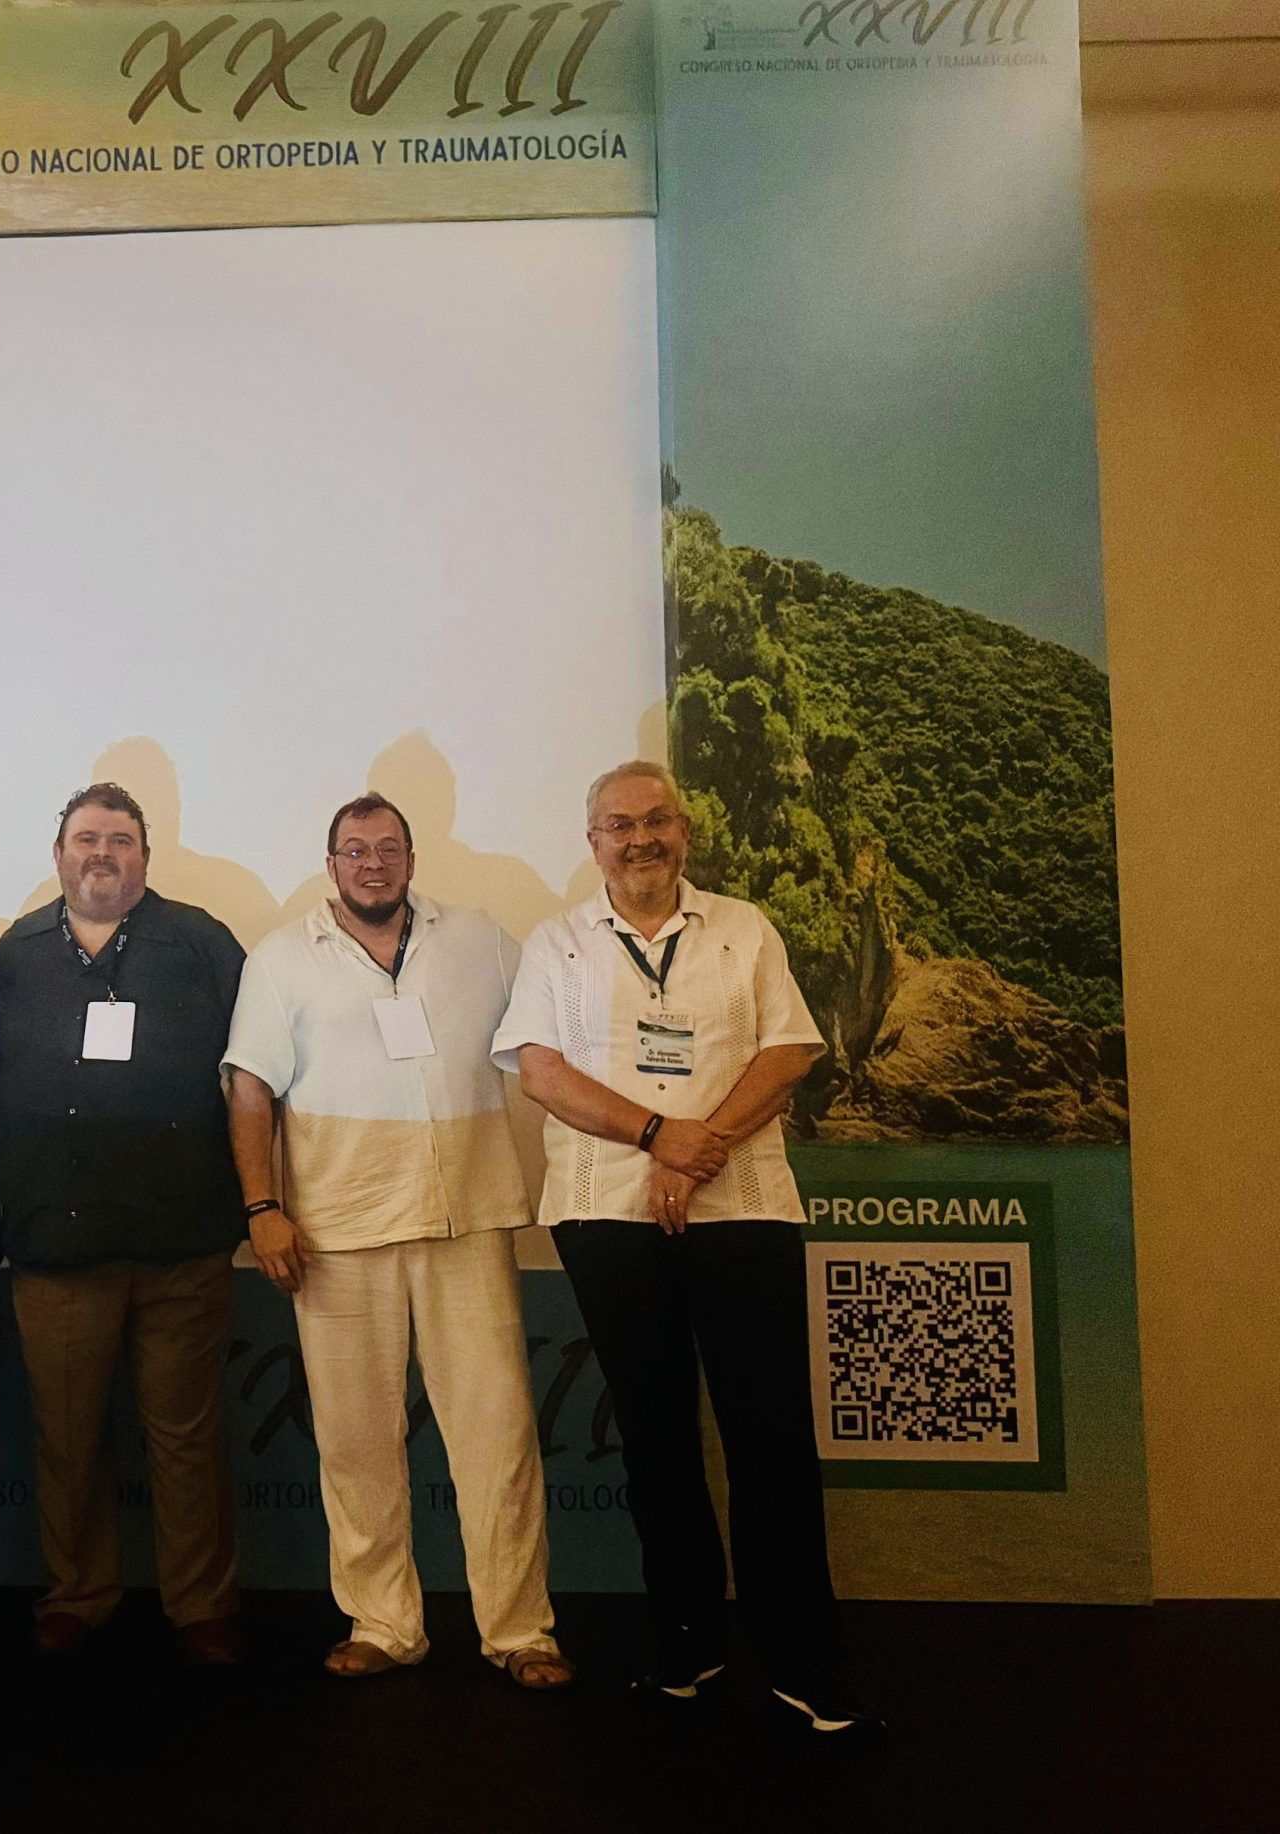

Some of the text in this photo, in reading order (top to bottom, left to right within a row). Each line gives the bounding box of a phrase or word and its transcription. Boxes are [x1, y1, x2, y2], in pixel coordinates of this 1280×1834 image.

[120, 1, 624, 125] XXVIII
[680, 60, 752, 73] CONGRESO
[756, 58, 819, 72] NACIONAL
[826, 58, 841, 71] DE
[846, 56, 918, 71] ORTOPEDIA
[30, 146, 163, 173] NACIONAL
[173, 146, 205, 171] DE
[216, 142, 360, 169] ORTOPEDIA
[372, 140, 386, 164] Y
[399, 129, 628, 163] TRAUMATOLOGÍA
[808, 1197, 1028, 1226] PROGRAMA
